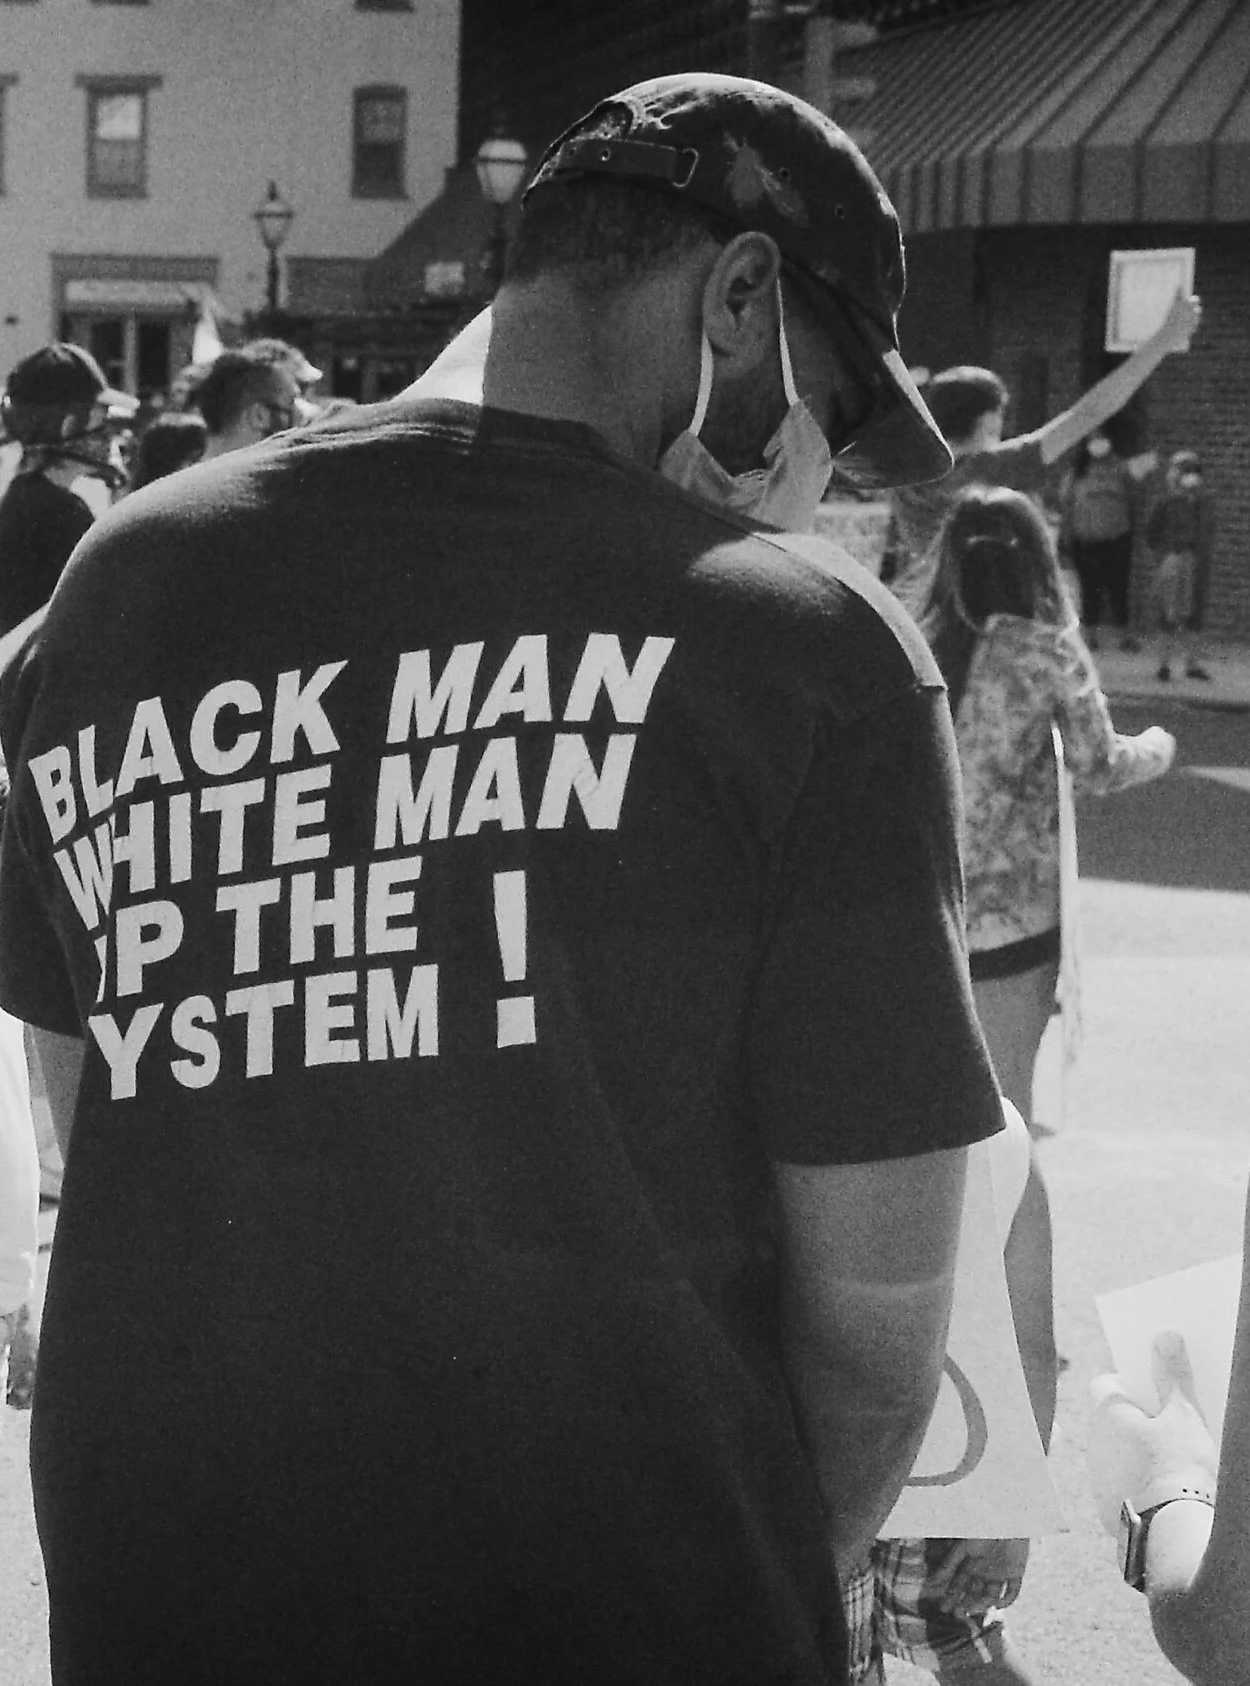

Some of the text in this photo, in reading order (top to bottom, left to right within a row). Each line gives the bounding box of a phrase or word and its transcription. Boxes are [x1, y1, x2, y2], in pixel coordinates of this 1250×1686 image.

[28, 633, 675, 844] BLACK MAN
[54, 734, 636, 930] WHITE MAN
[88, 870, 536, 1100] YSTEM !
[216, 856, 422, 974] THE
